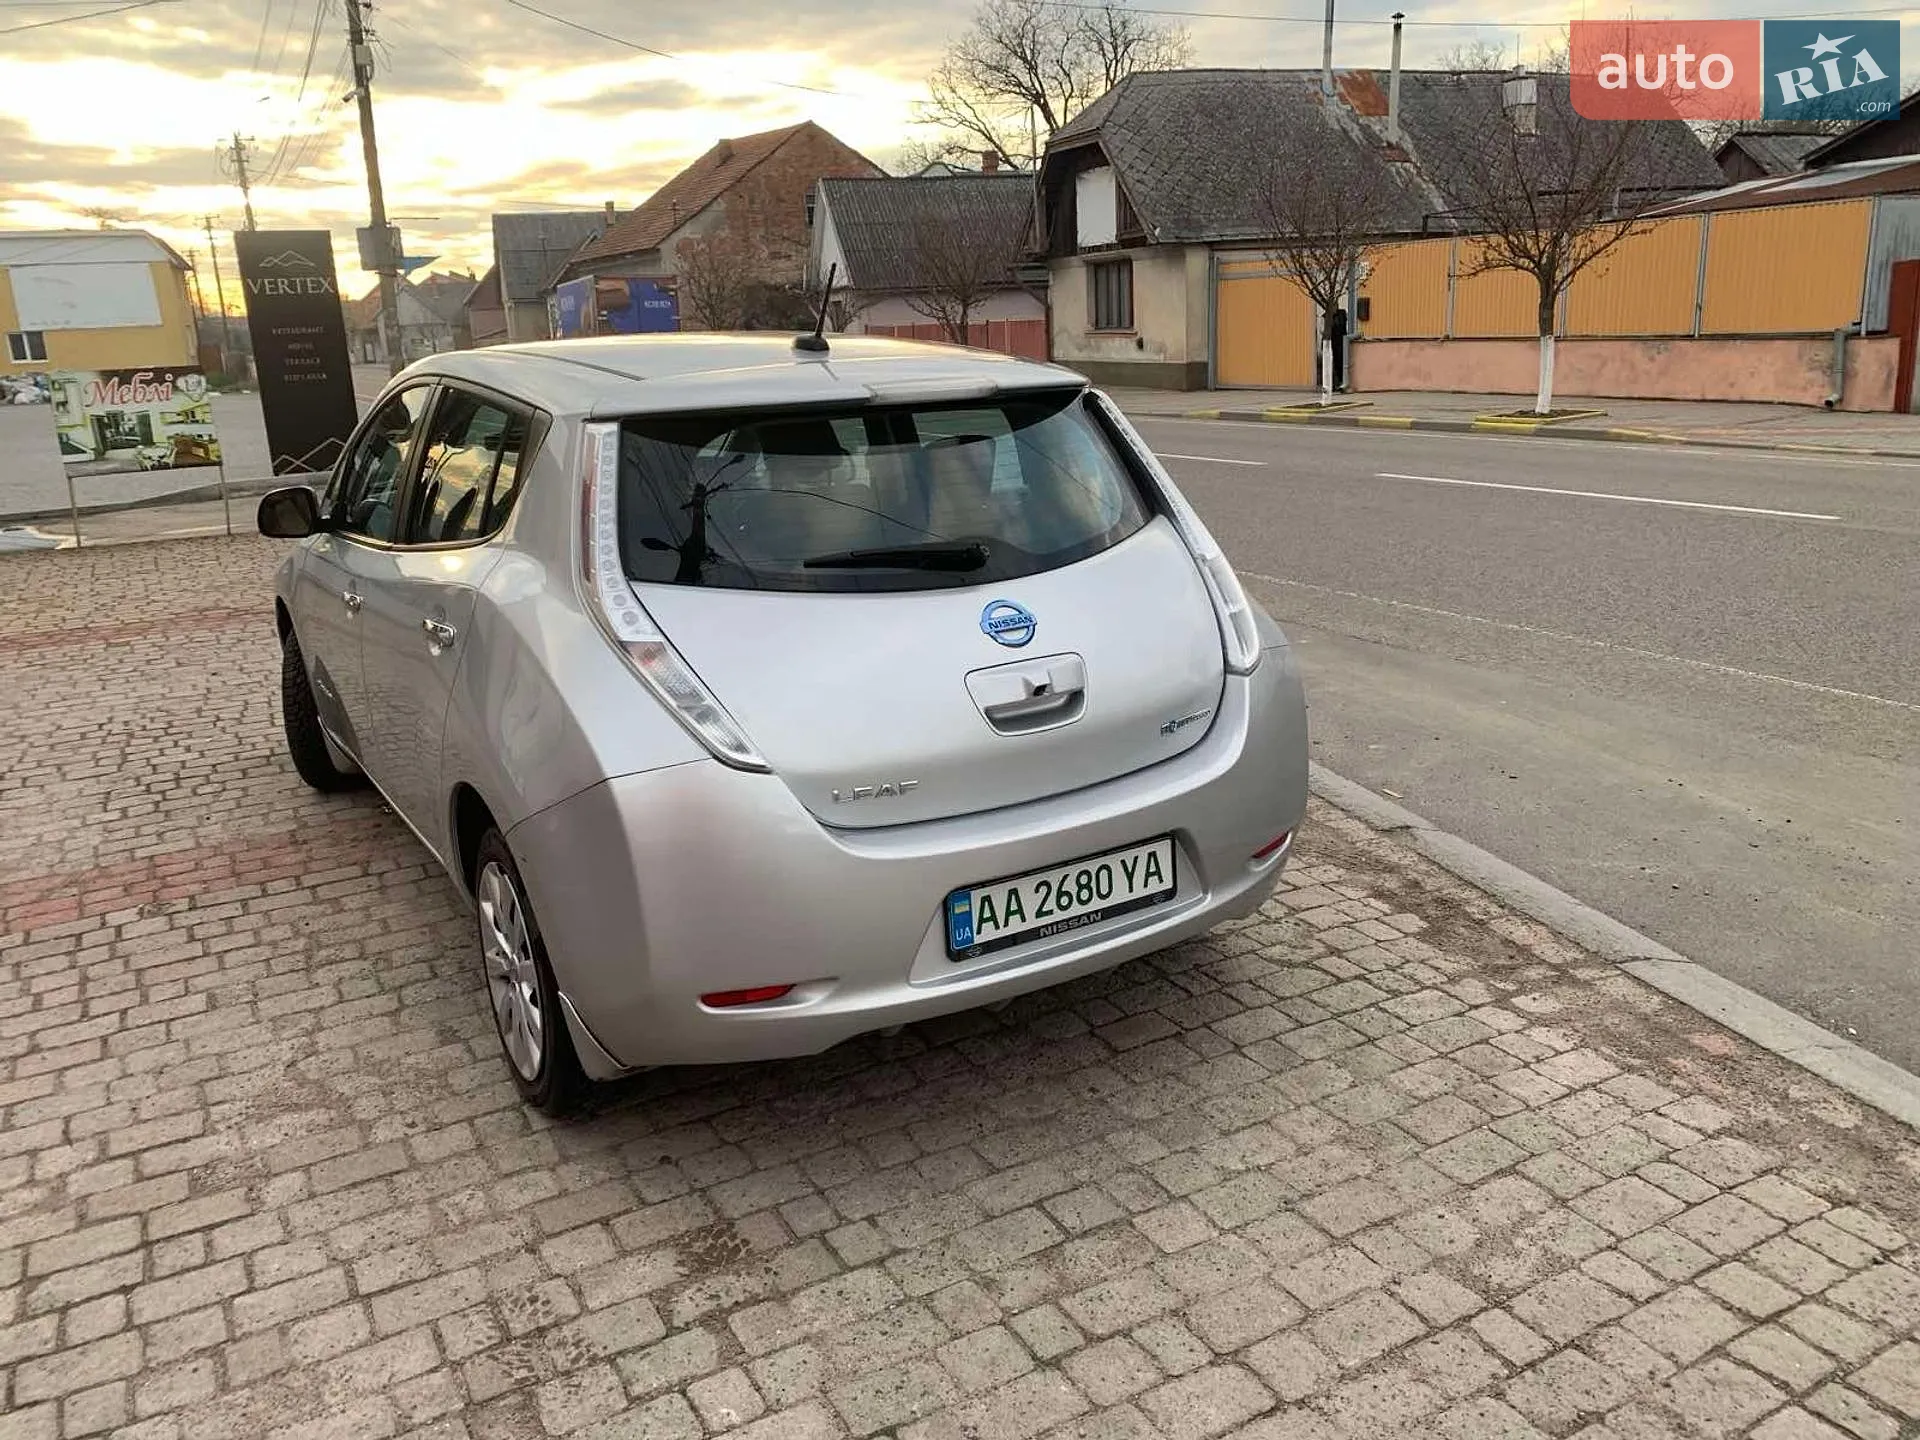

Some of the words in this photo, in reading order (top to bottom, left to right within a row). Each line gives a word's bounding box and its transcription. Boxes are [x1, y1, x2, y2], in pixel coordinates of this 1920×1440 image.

[246, 276, 336, 296] VERTEX
[81, 372, 173, 408] Меблі
[987, 614, 1033, 630] NISSAN
[976, 887, 1027, 936] AA
[1034, 863, 1114, 920] 2680
[1120, 850, 1164, 893] YA
[955, 928, 972, 942] UA
[1038, 911, 1102, 938] NISSAN
